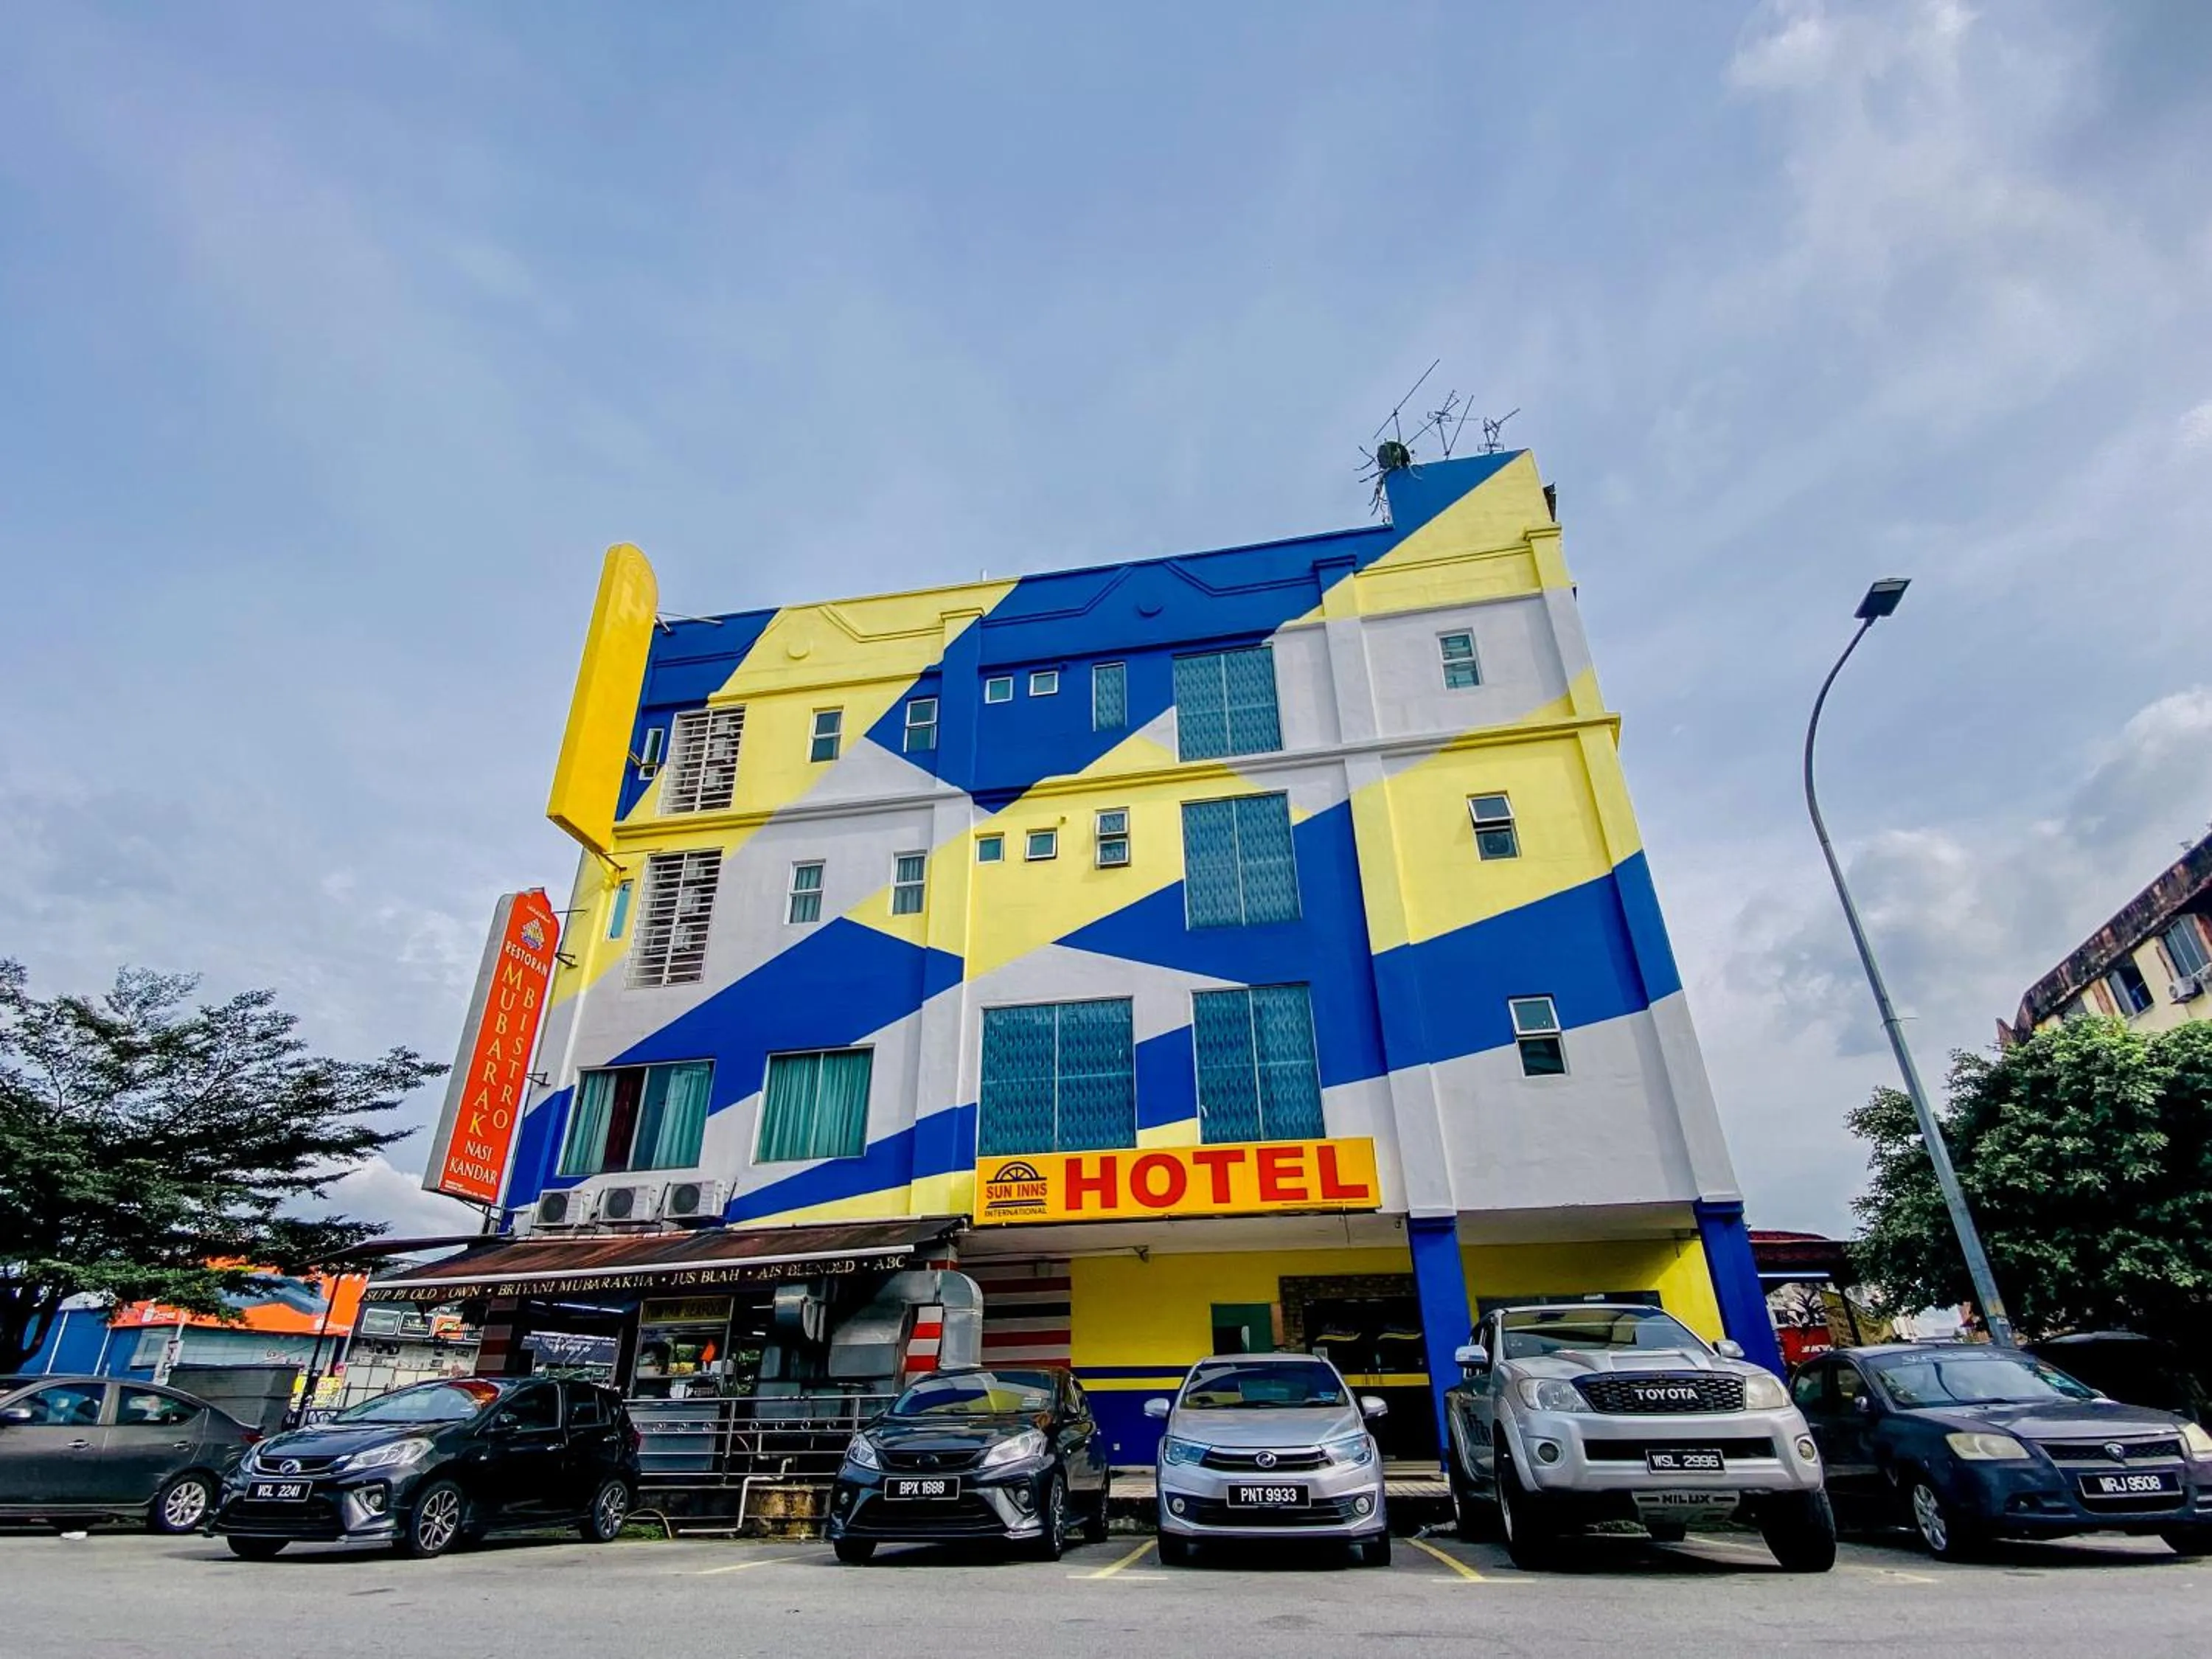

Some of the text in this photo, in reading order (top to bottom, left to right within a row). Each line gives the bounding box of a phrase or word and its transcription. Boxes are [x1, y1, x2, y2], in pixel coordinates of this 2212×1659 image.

[505, 941, 548, 977] RESTORAN
[468, 961, 523, 1138] MUBARAK
[493, 987, 535, 1129] BISTRO
[465, 1140, 493, 1161] NASI
[449, 1157, 498, 1186] KANDAR
[1065, 1145, 1369, 1211] HOTEL
[986, 1182, 1047, 1199] SUN INNS
[984, 1207, 1047, 1217] INTERNATIONAL
[364, 1289, 392, 1301] SUP
[409, 1288, 437, 1300] OLD
[670, 1272, 696, 1285] JUS
[757, 1264, 782, 1280] AIS
[787, 1259, 855, 1276] BLENDED
[873, 1255, 906, 1270] ABC
[1634, 1388, 1699, 1400] TOYOTA
[1652, 1455, 1719, 1468] WSL 2996
[257, 1484, 302, 1498] VCL 2241
[900, 1481, 919, 1495] BPX
[2099, 1475, 2161, 1492] WRJ 9508
[1240, 1487, 1297, 1502] PNT 9933
[1662, 1494, 1711, 1505] HILUX
